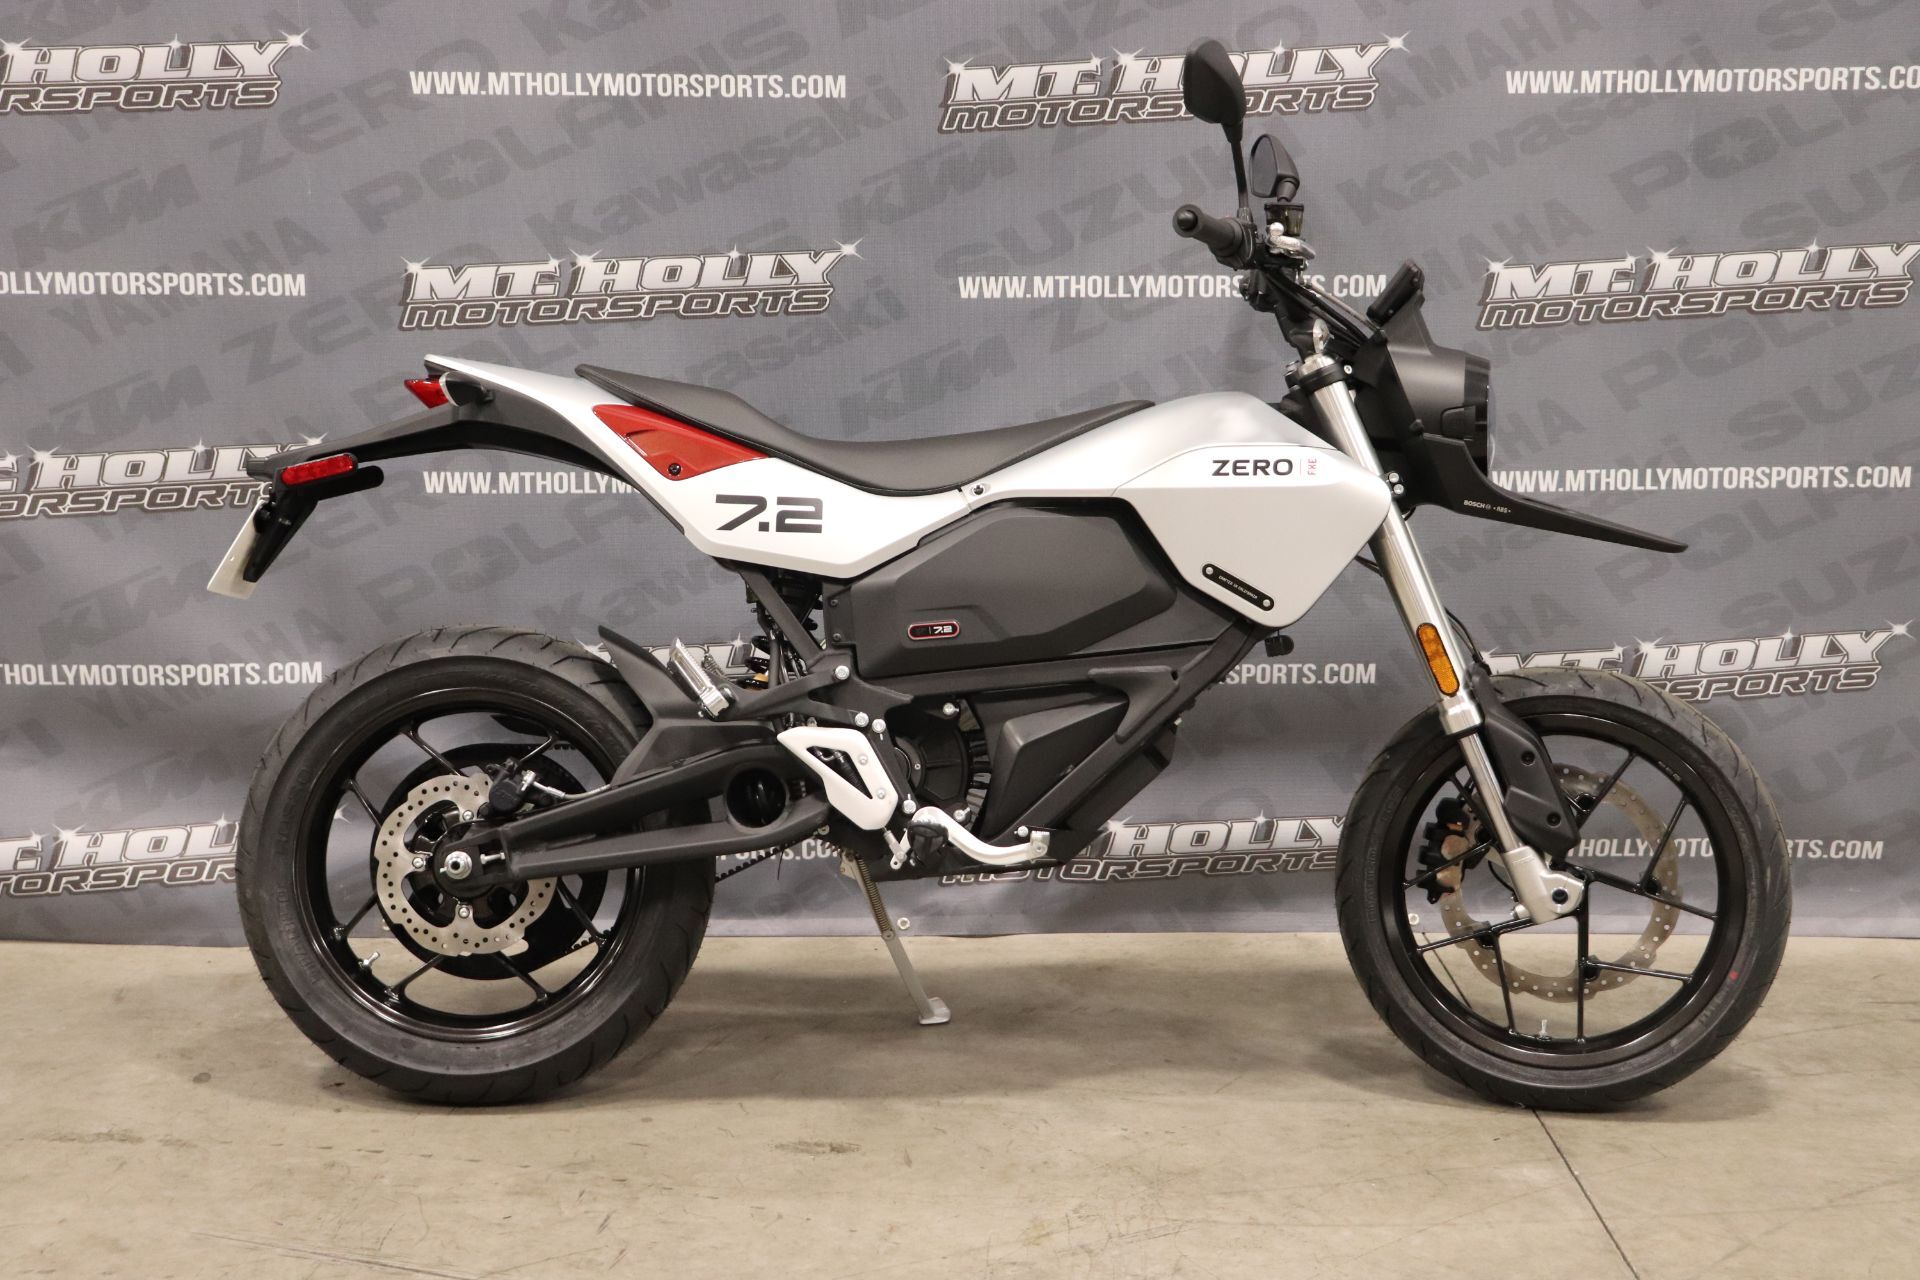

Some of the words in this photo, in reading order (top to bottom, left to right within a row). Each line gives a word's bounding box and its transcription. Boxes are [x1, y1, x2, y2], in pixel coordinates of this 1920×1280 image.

[2, 41, 291, 84] HOLLY
[1111, 44, 1394, 95] HLLY
[410, 71, 847, 98] WWW.MTHOLLYMOTORSPORTS.COM
[571, 249, 846, 294] HOLLY
[1644, 242, 1920, 292] HOLLY
[403, 288, 834, 328] MOTORSPORTS
[1480, 280, 1914, 328] MOTORSPORTS
[30, 443, 312, 491] HOLL
[423, 471, 642, 494] WWW.MTHOLLYM
[1212, 458, 1294, 477] ZERO
[1492, 466, 1912, 493] WWW.MTHOLLYMOTORSPORTS.COM
[714, 494, 824, 534] 7.2
[933, 625, 953, 635] 7.2
[1219, 663, 1377, 685] SPORTS.COM
[1633, 630, 1892, 679] HOLLY
[53, 822, 238, 870] HOL
